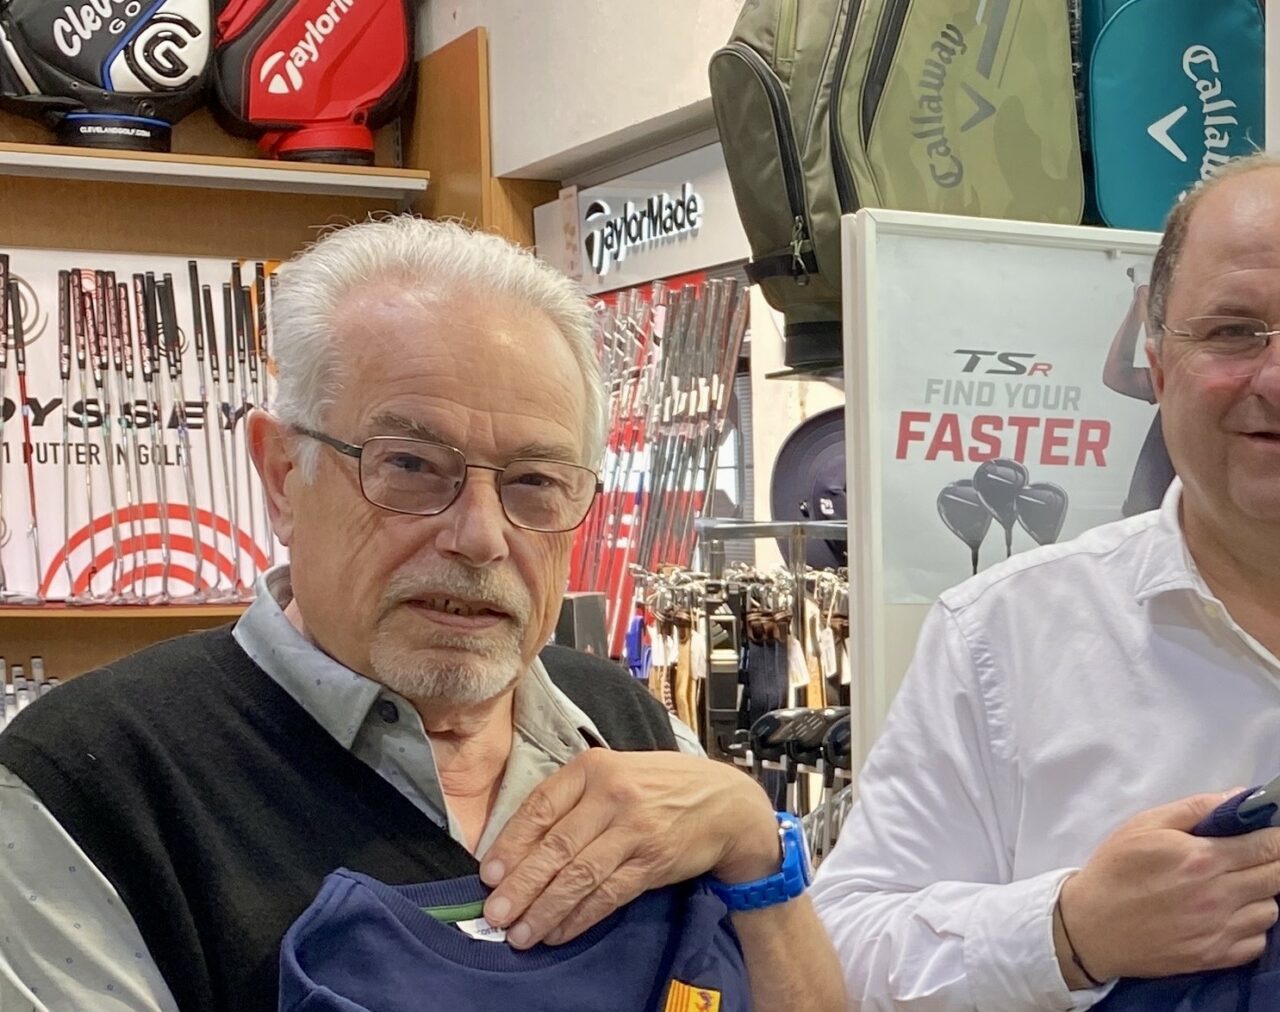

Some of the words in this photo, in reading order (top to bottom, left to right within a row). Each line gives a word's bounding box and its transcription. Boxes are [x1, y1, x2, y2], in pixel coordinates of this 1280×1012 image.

[909, 23, 968, 189] Callaway
[584, 182, 699, 275] TaylorMade
[953, 349, 1053, 377] TSR
[925, 379, 995, 408] FIND
[1005, 382, 1082, 411] YOUR
[895, 411, 1112, 467] FASTER
